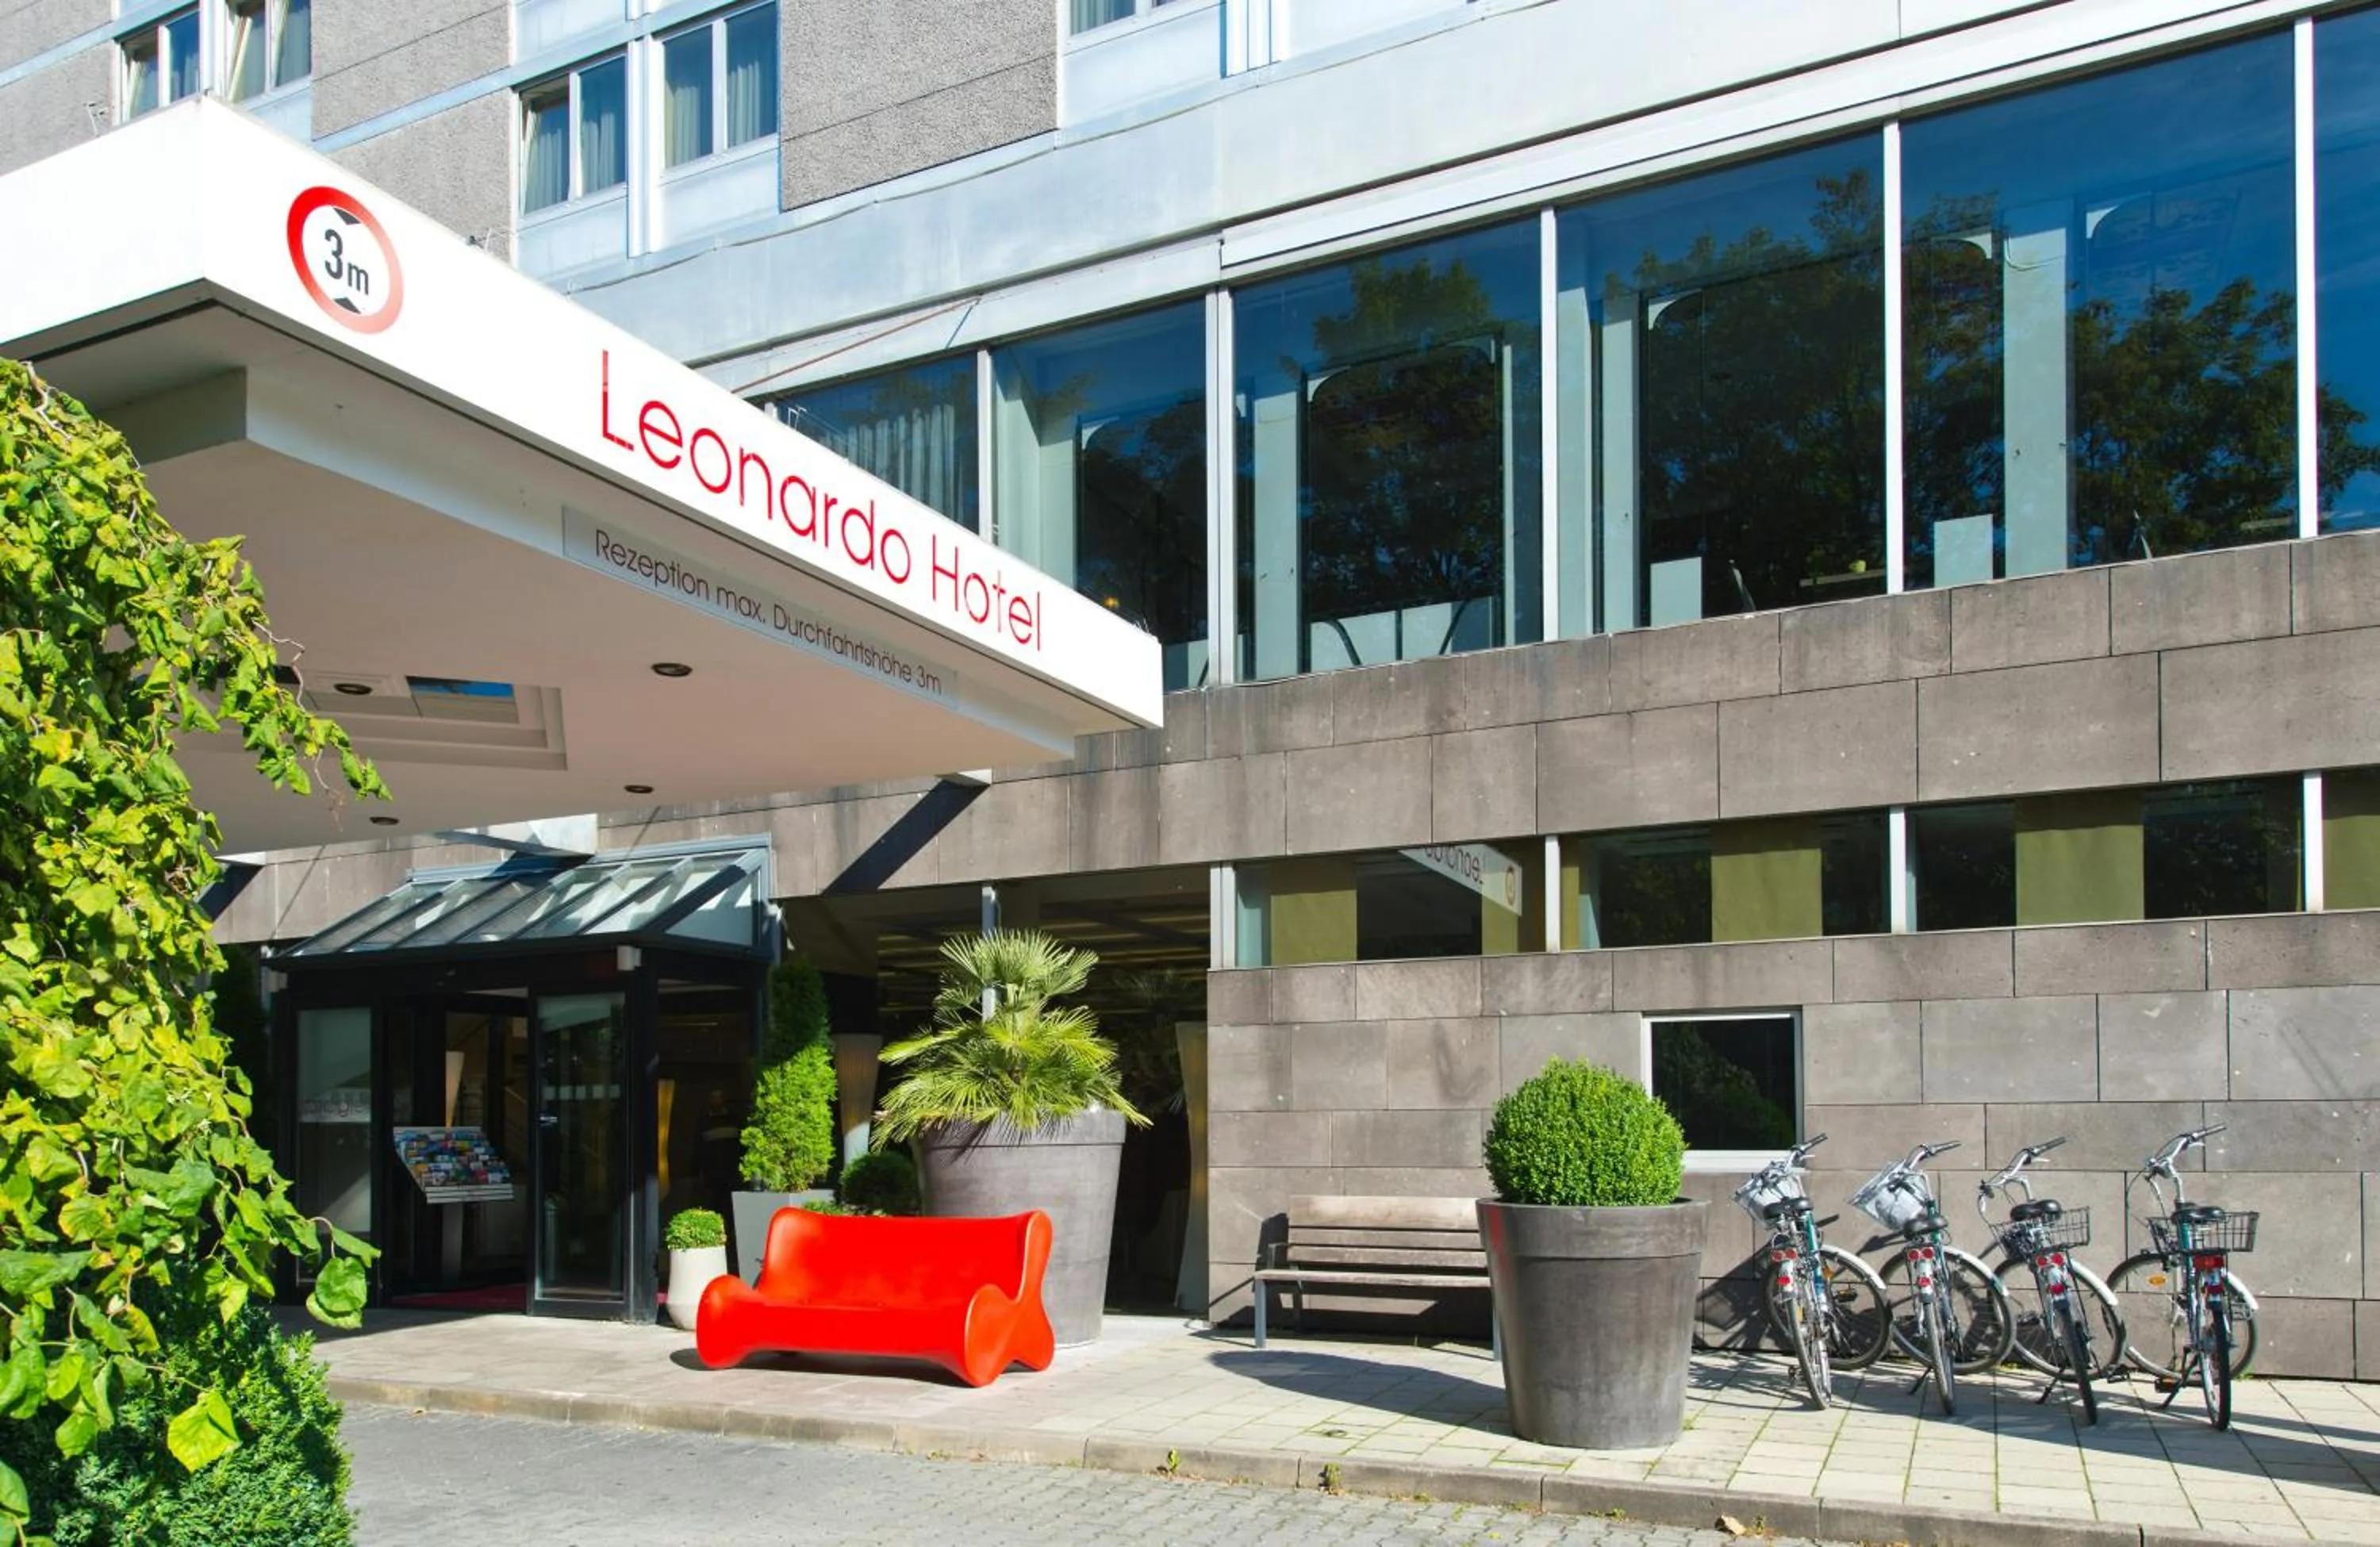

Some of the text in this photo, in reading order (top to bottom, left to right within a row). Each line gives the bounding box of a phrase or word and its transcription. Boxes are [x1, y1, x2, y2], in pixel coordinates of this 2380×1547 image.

[324, 228, 370, 296] 3m
[601, 349, 1042, 651] Leonardo Hotel
[596, 529, 942, 696] Rezeption max. Durchfahrtshöhe 3m
